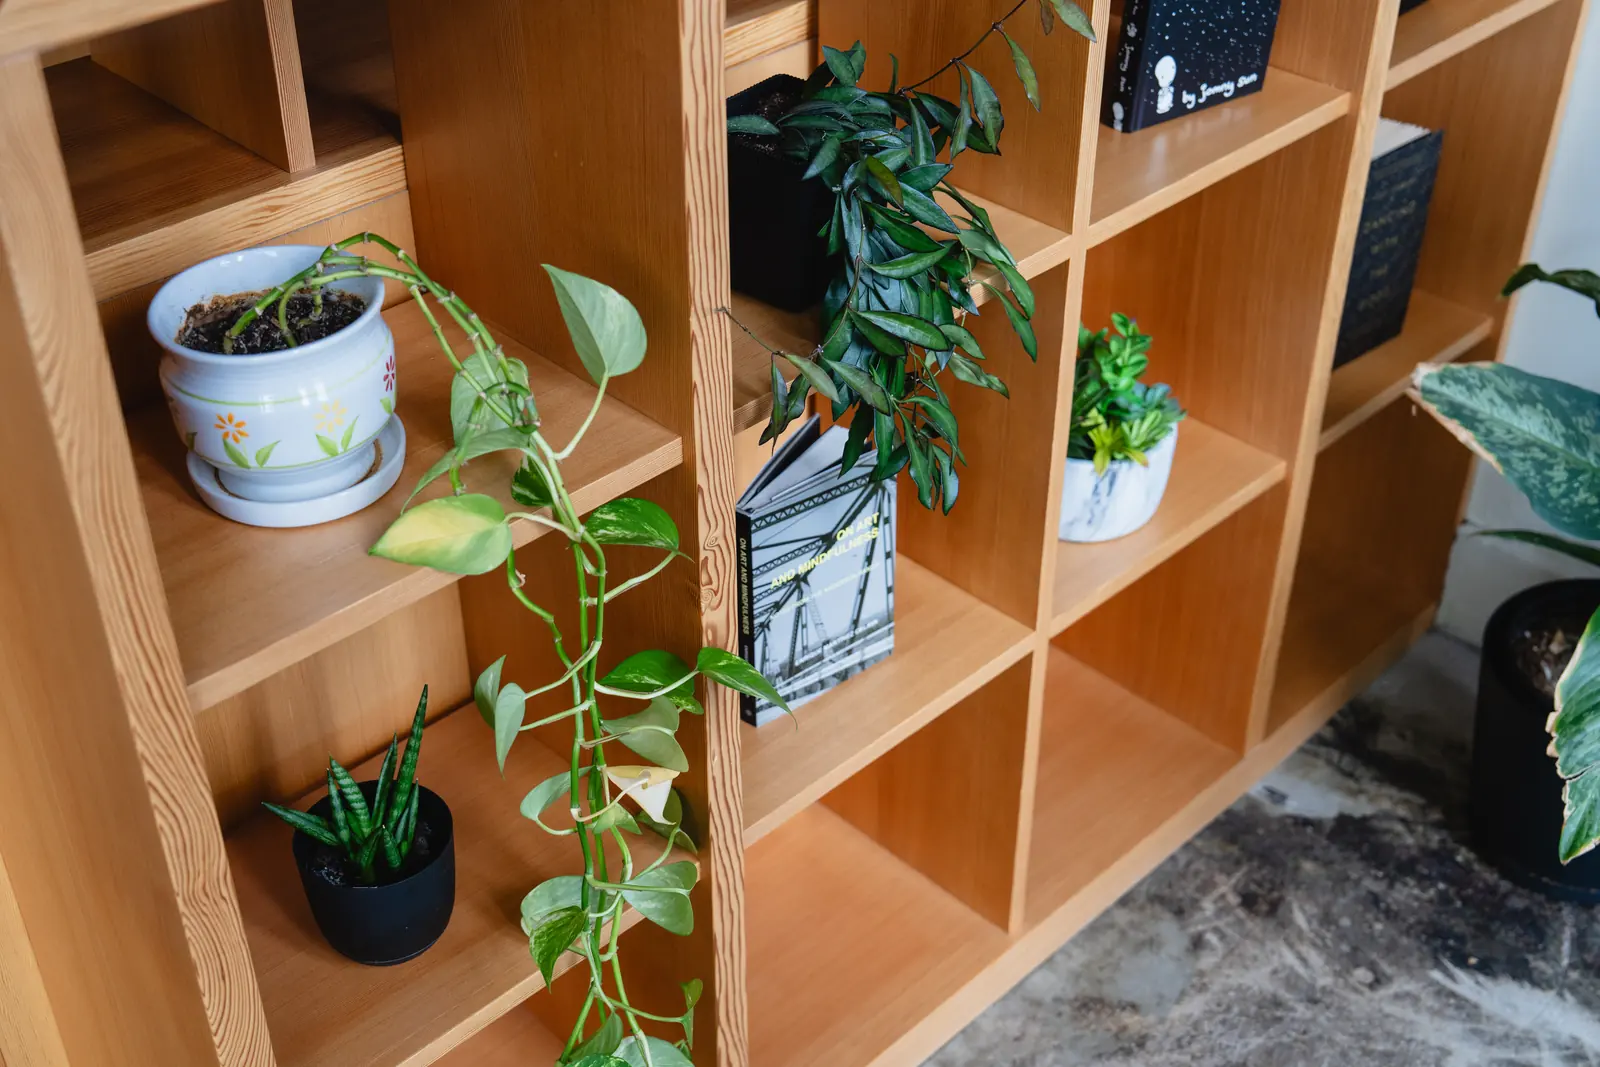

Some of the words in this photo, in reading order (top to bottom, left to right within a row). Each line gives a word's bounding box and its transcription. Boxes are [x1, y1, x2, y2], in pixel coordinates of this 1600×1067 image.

[1182, 90, 1196, 109] by
[836, 525, 855, 541] ON
[855, 512, 879, 533] ART
[740, 538, 747, 547] ON
[770, 568, 796, 589] AND
[798, 527, 879, 575] MINDFULNESS
[742, 583, 750, 635] MINDFULNESS
